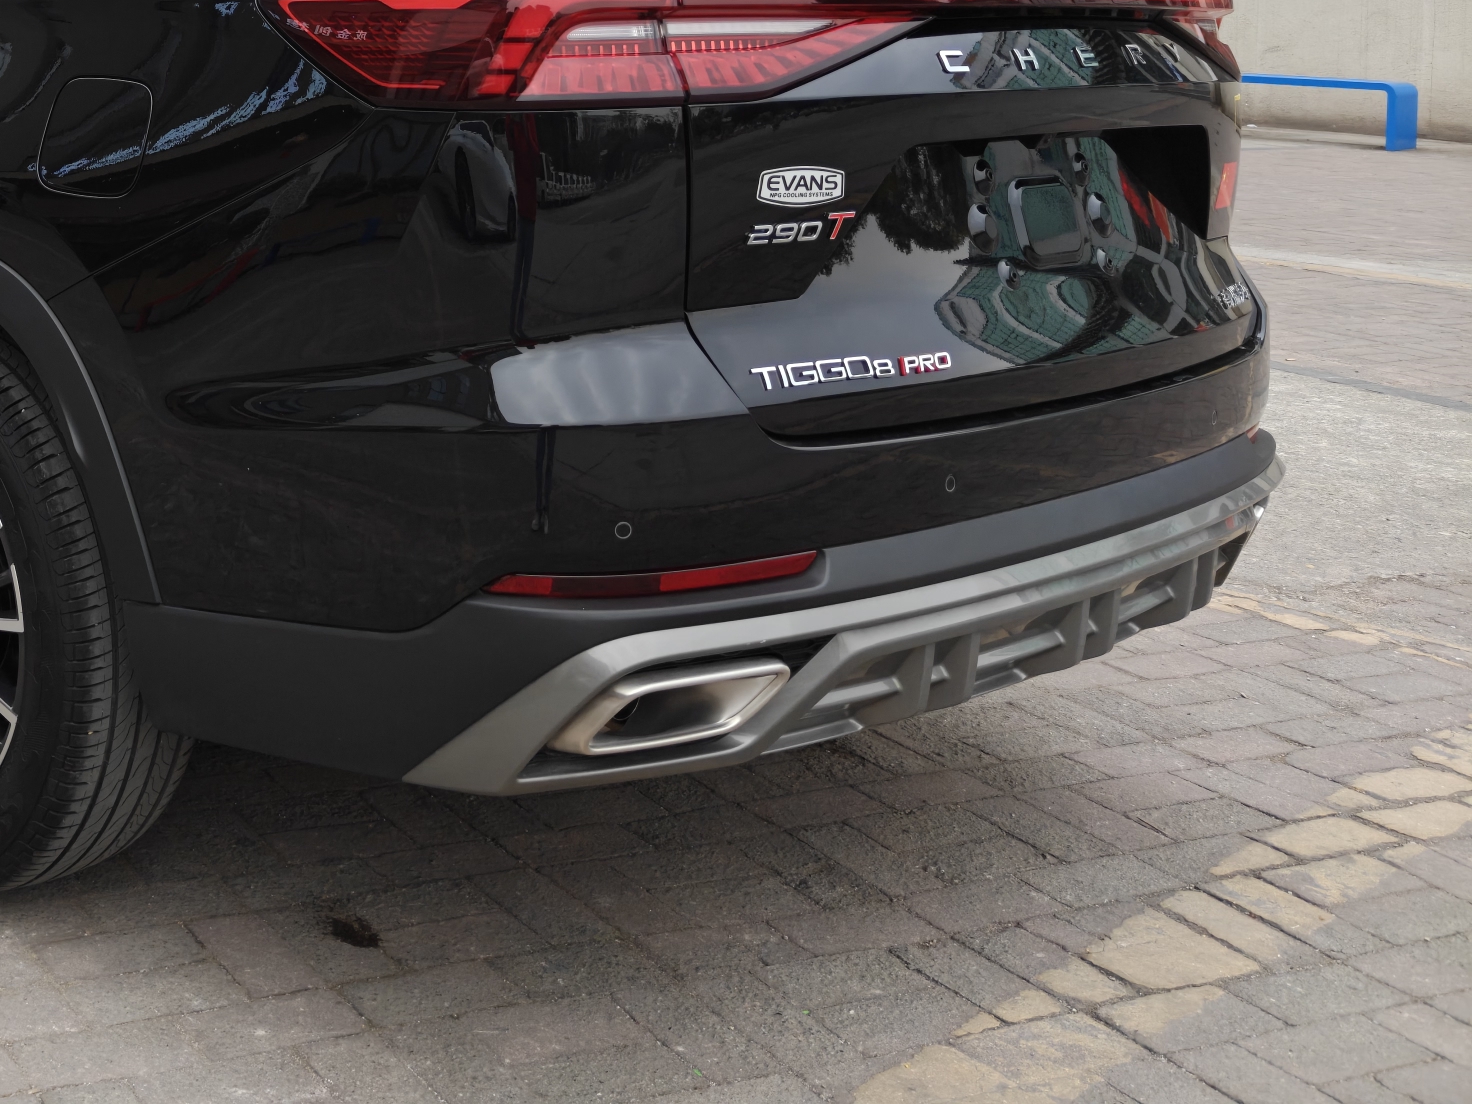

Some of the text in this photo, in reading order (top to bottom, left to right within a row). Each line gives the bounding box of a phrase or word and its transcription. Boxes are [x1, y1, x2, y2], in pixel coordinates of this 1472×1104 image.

[935, 43, 1180, 74] CHERY
[766, 175, 838, 192] EVANS
[903, 351, 952, 376] PRO
